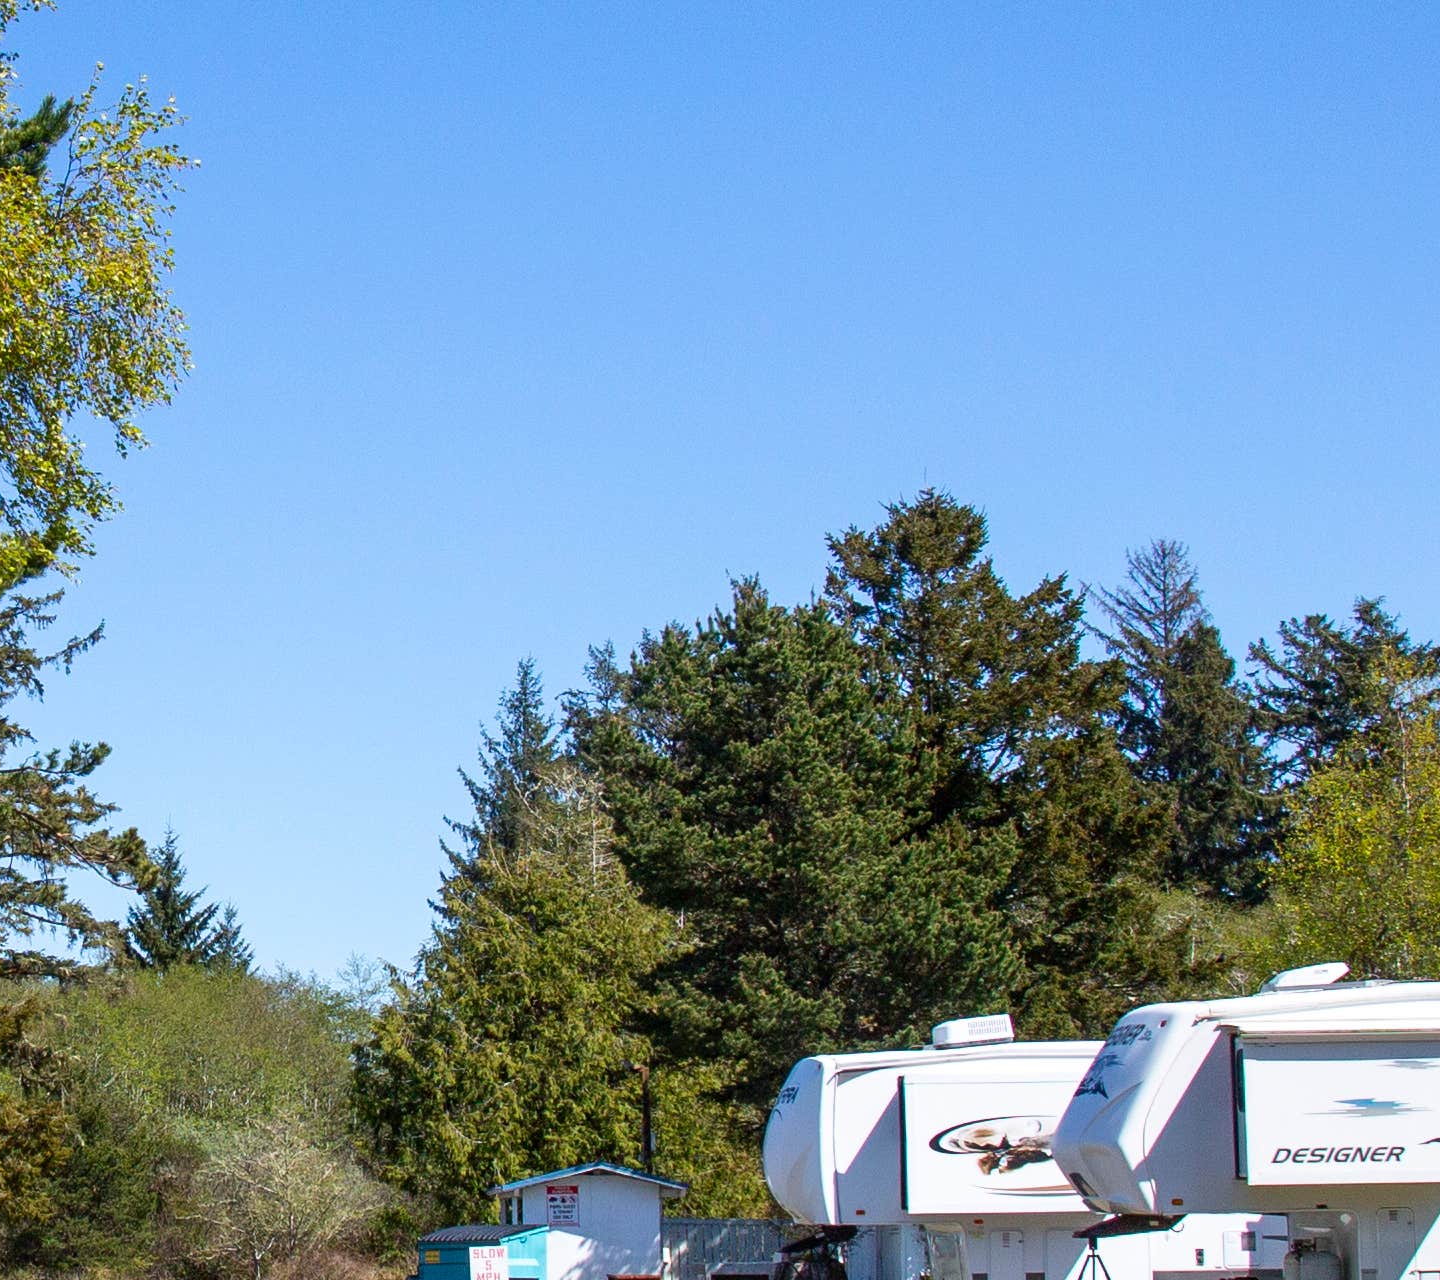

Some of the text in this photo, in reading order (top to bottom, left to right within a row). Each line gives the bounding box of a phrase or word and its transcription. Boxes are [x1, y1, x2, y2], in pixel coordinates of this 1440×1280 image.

[1271, 1146, 1406, 1164] DESIGNER
[473, 1248, 505, 1259] SLOW
[485, 1260, 492, 1271] 5
